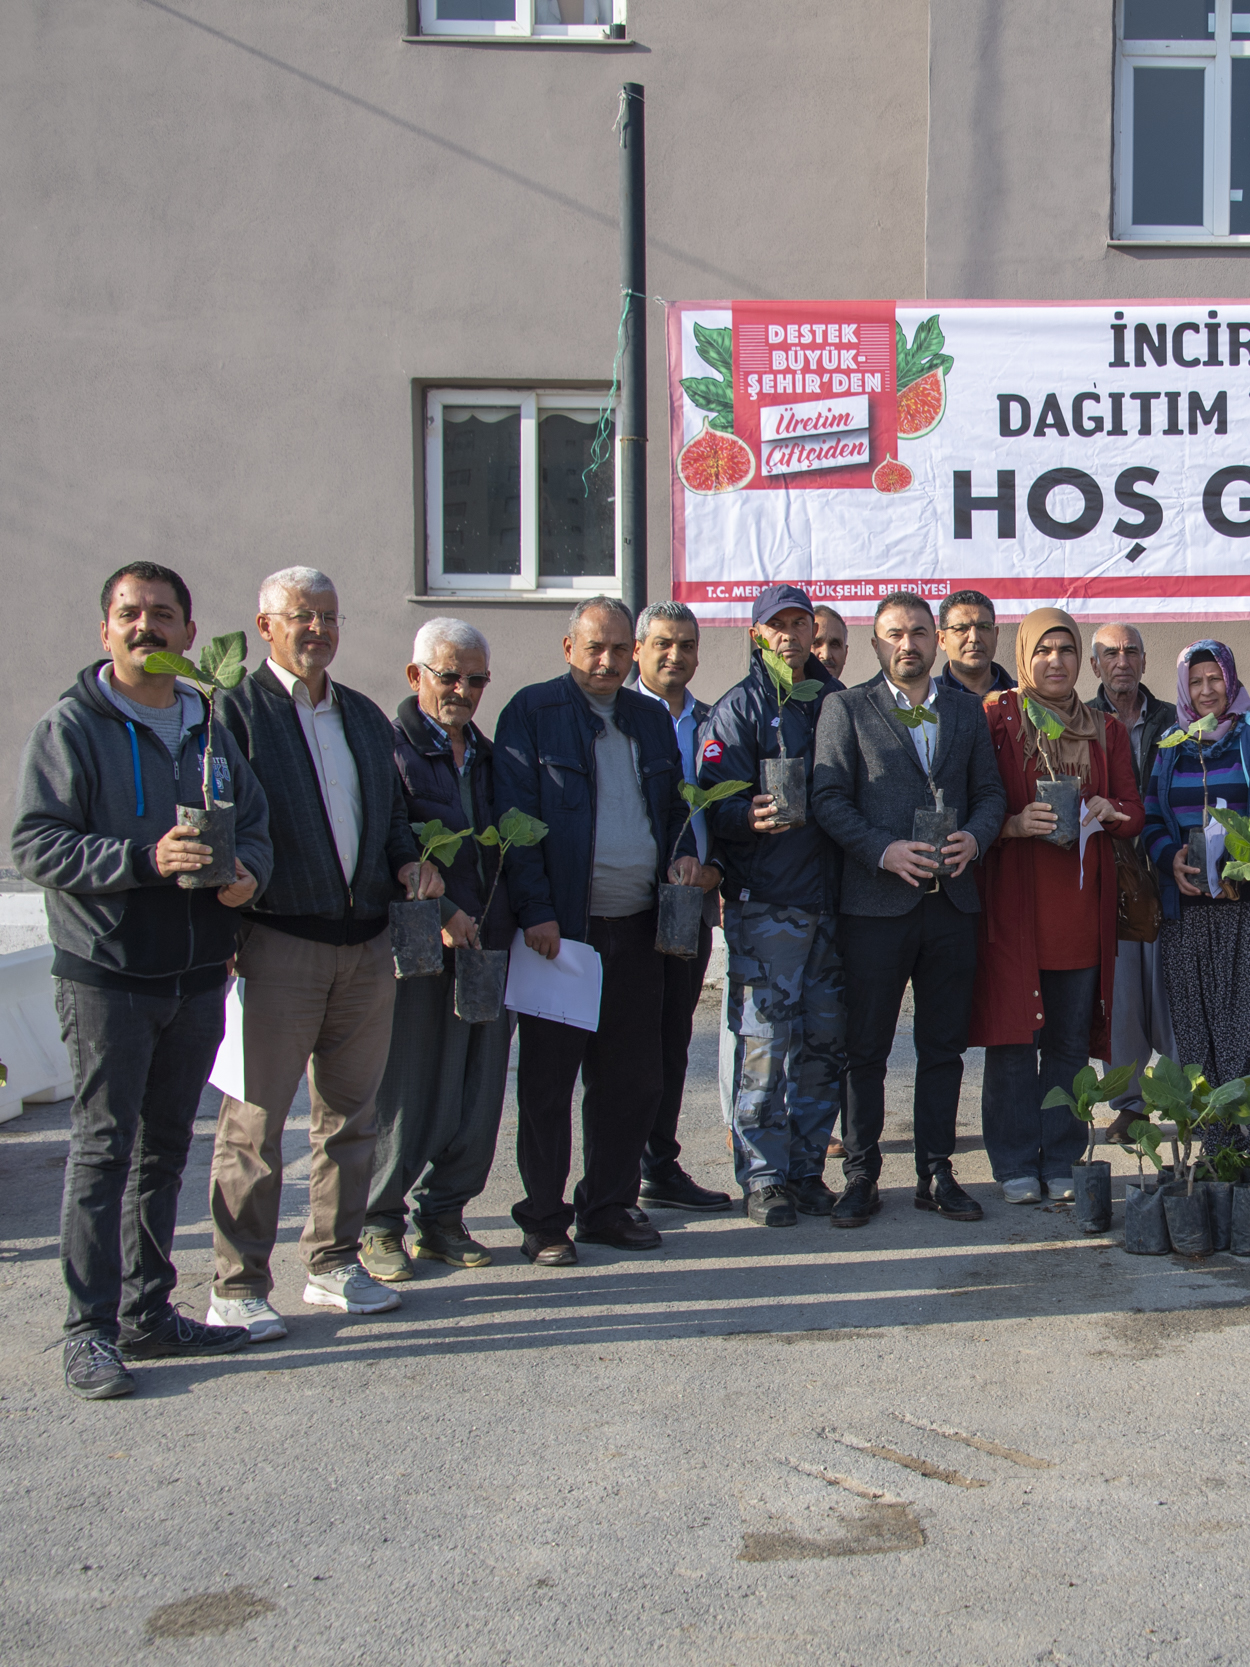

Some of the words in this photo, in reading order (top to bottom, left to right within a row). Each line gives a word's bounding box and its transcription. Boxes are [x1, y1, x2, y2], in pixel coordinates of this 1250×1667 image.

[768, 323, 859, 343] DESTEK
[772, 346, 866, 370] BÜYÜK-
[775, 407, 854, 435] Üretim
[765, 437, 868, 473] Çiftçiden
[953, 466, 1164, 563] HOŞ
[706, 586, 729, 598] T.C.
[793, 581, 874, 599] ÜYÜKŞEHİR
